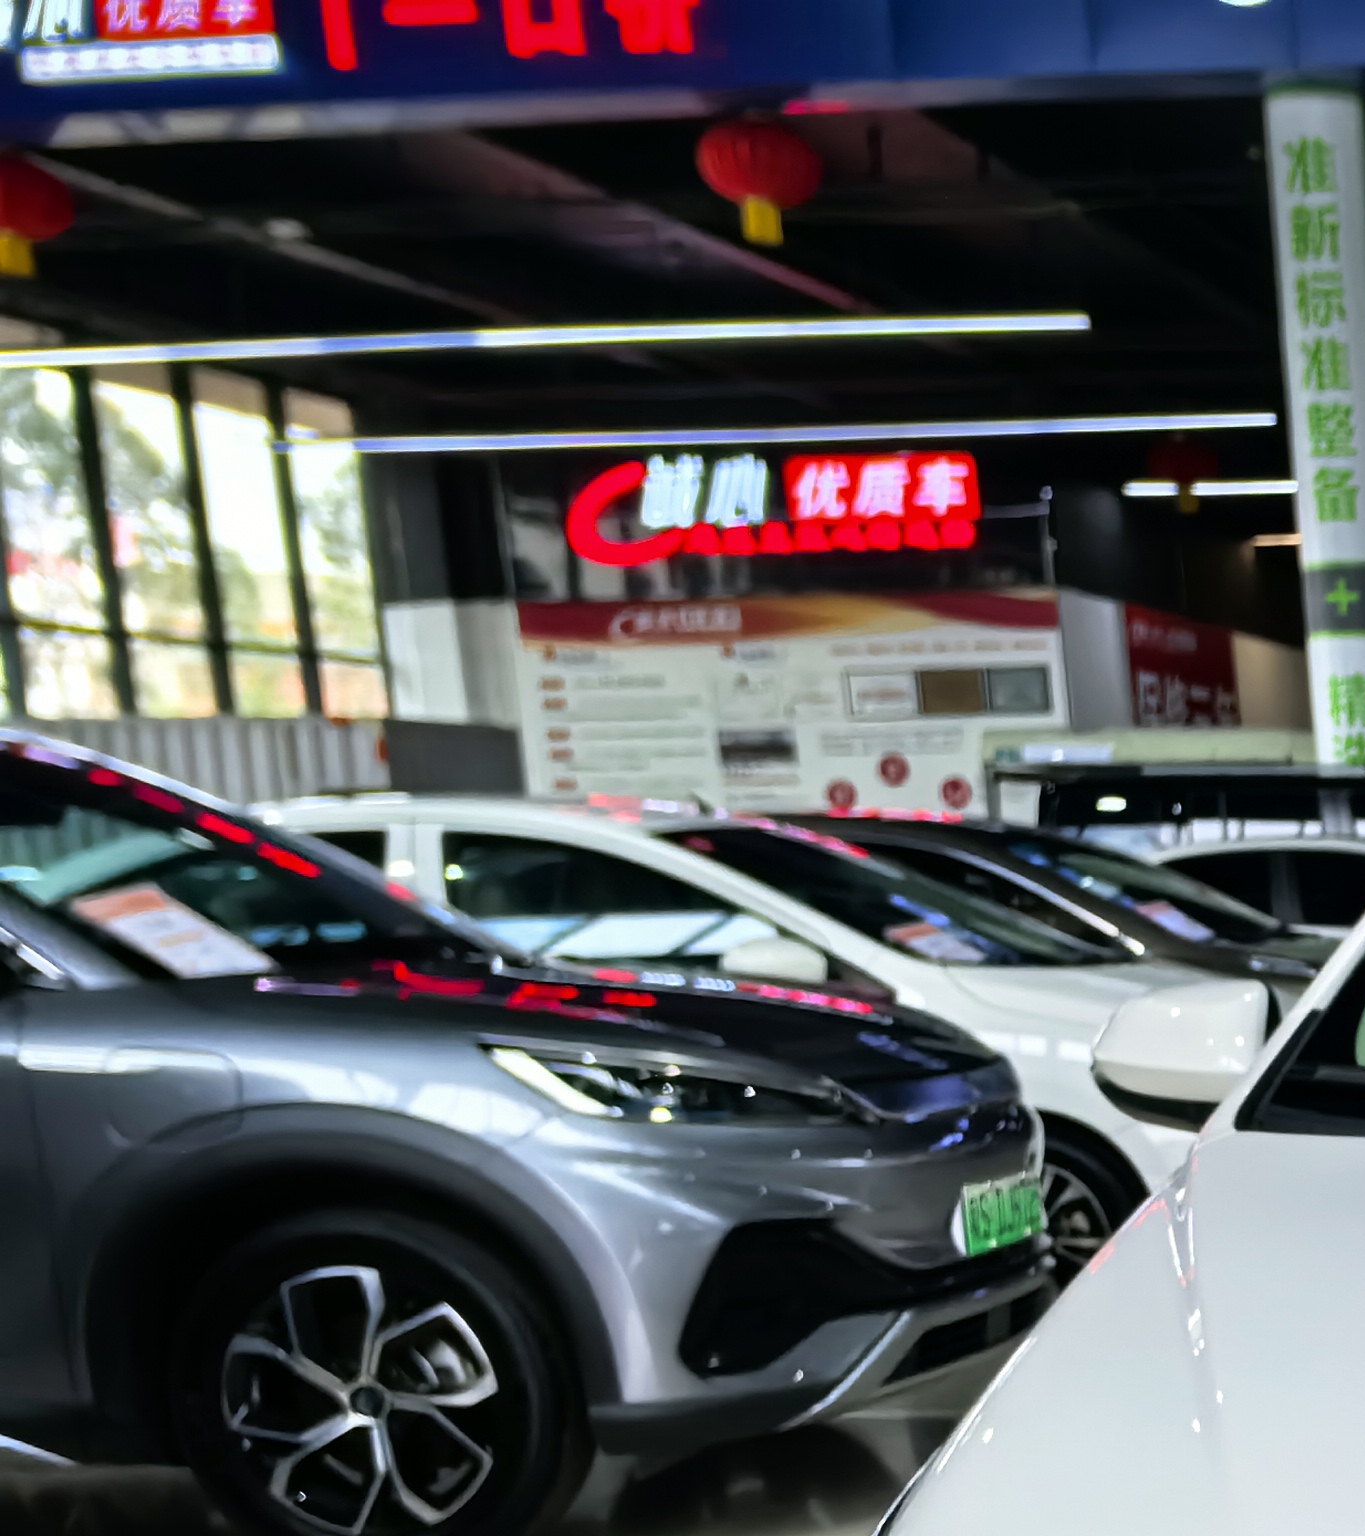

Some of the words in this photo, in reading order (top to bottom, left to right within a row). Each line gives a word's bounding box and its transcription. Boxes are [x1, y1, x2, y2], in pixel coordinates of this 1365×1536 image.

[1283, 136, 1358, 522] 准新标准整备
[793, 459, 970, 518] 优质车
